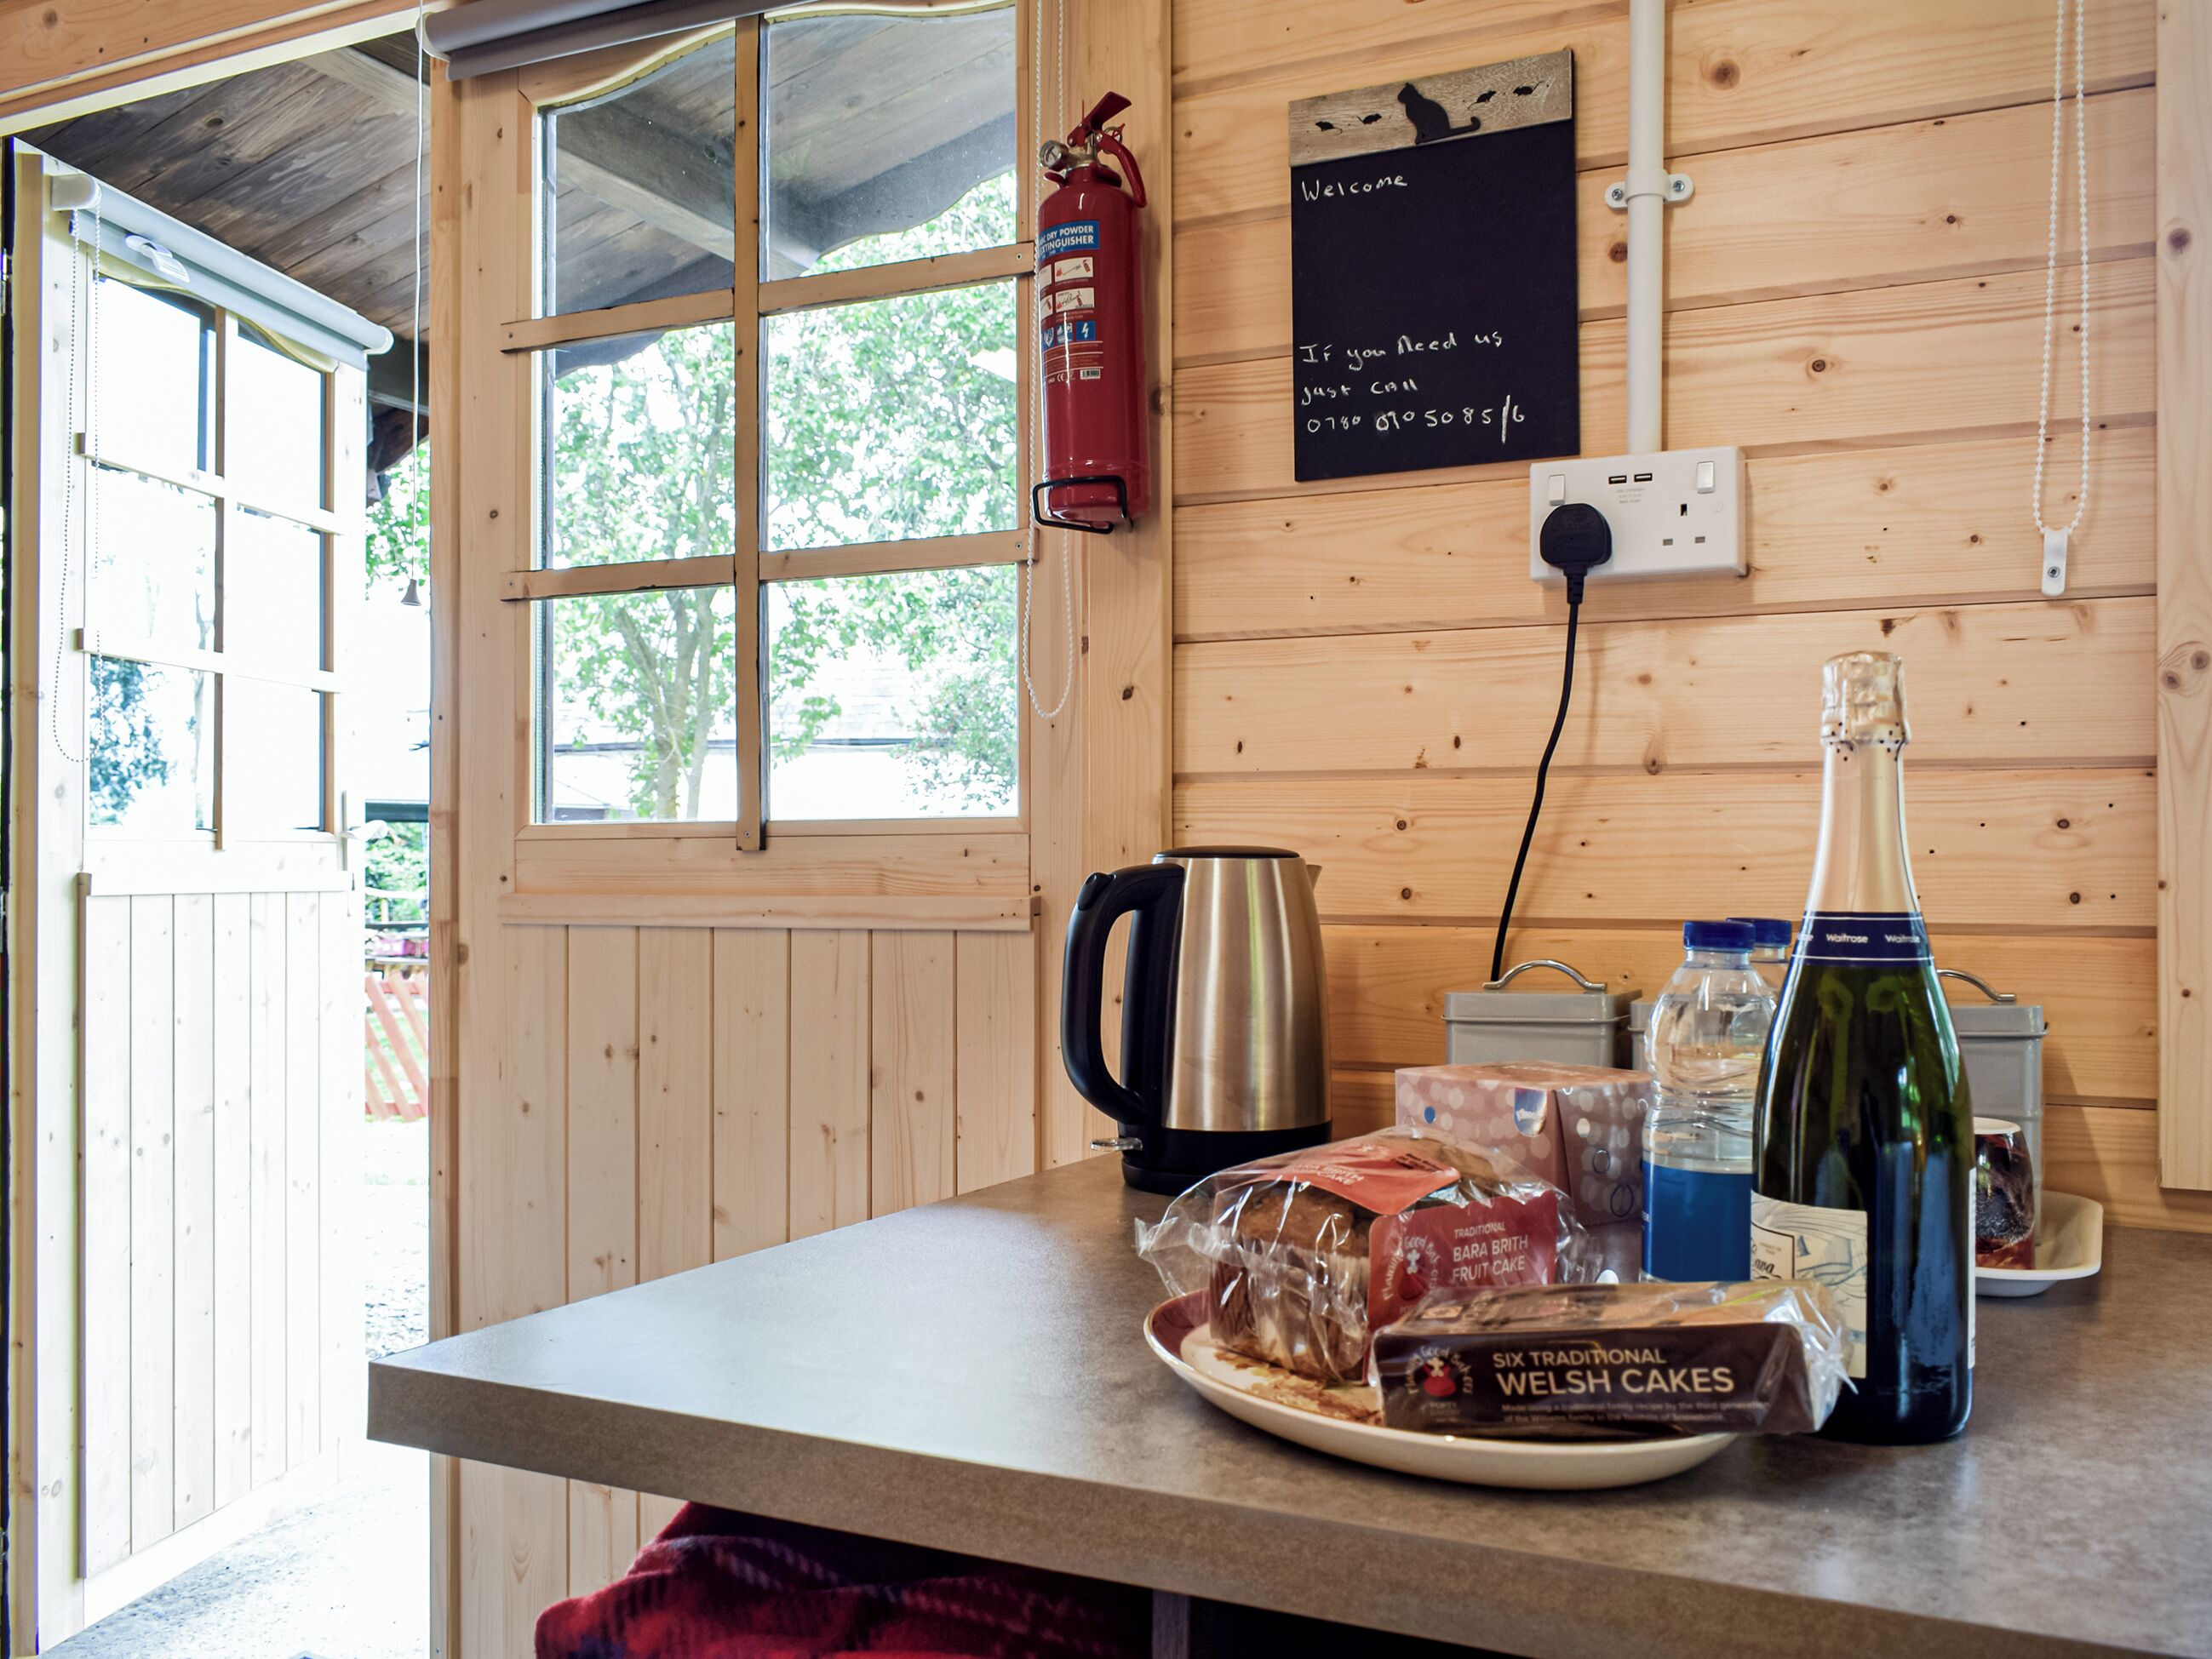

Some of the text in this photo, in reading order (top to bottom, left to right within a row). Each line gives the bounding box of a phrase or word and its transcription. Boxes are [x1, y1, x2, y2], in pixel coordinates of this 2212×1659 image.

[1301, 174, 1407, 201] Welcome
[1046, 230, 1058, 242] DRY
[1059, 226, 1094, 237] POWDER
[1040, 235, 1094, 255] EXTINGUISHER
[1299, 344, 1332, 363] If
[1347, 349, 1386, 370] you
[1474, 331, 1503, 347] us
[1301, 384, 1351, 405] just
[1826, 933, 1869, 944] Waitrose
[1455, 1221, 1506, 1239] TRADITIONAL
[1453, 1235, 1529, 1263] BARA BRITH
[1453, 1256, 1526, 1282] FRUIT CAKE
[1493, 1348, 1667, 1369] SIX TRADITIONAL
[1495, 1367, 1735, 1396] WELSH CAKES
